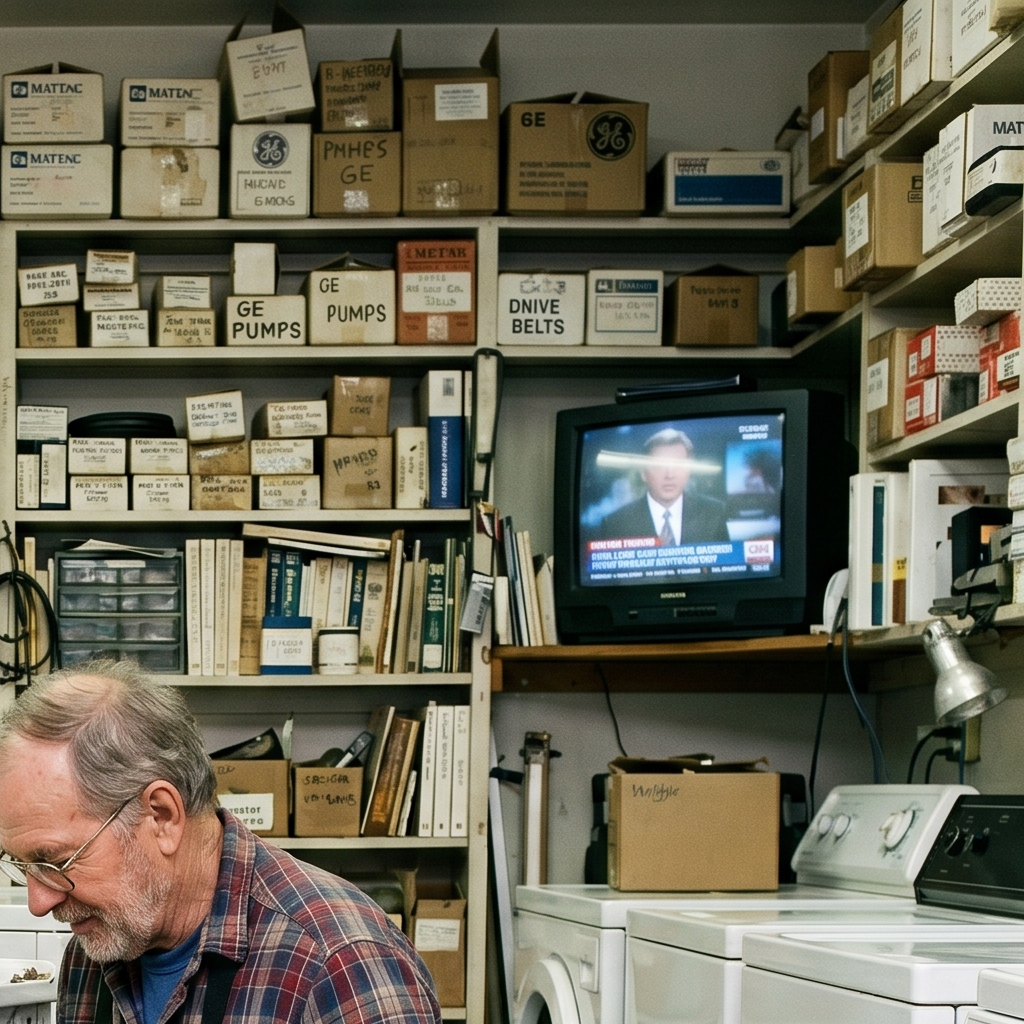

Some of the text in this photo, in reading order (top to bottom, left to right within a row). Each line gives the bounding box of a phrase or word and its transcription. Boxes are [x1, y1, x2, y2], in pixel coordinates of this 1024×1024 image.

[993, 121, 1024, 135] MAT
[340, 164, 375, 184] GE
[319, 278, 339, 293] GE
[236, 301, 264, 317] GE
[327, 304, 387, 322] PUMPS
[232, 322, 302, 340] PUMPS
[512, 318, 565, 335] BELTS
